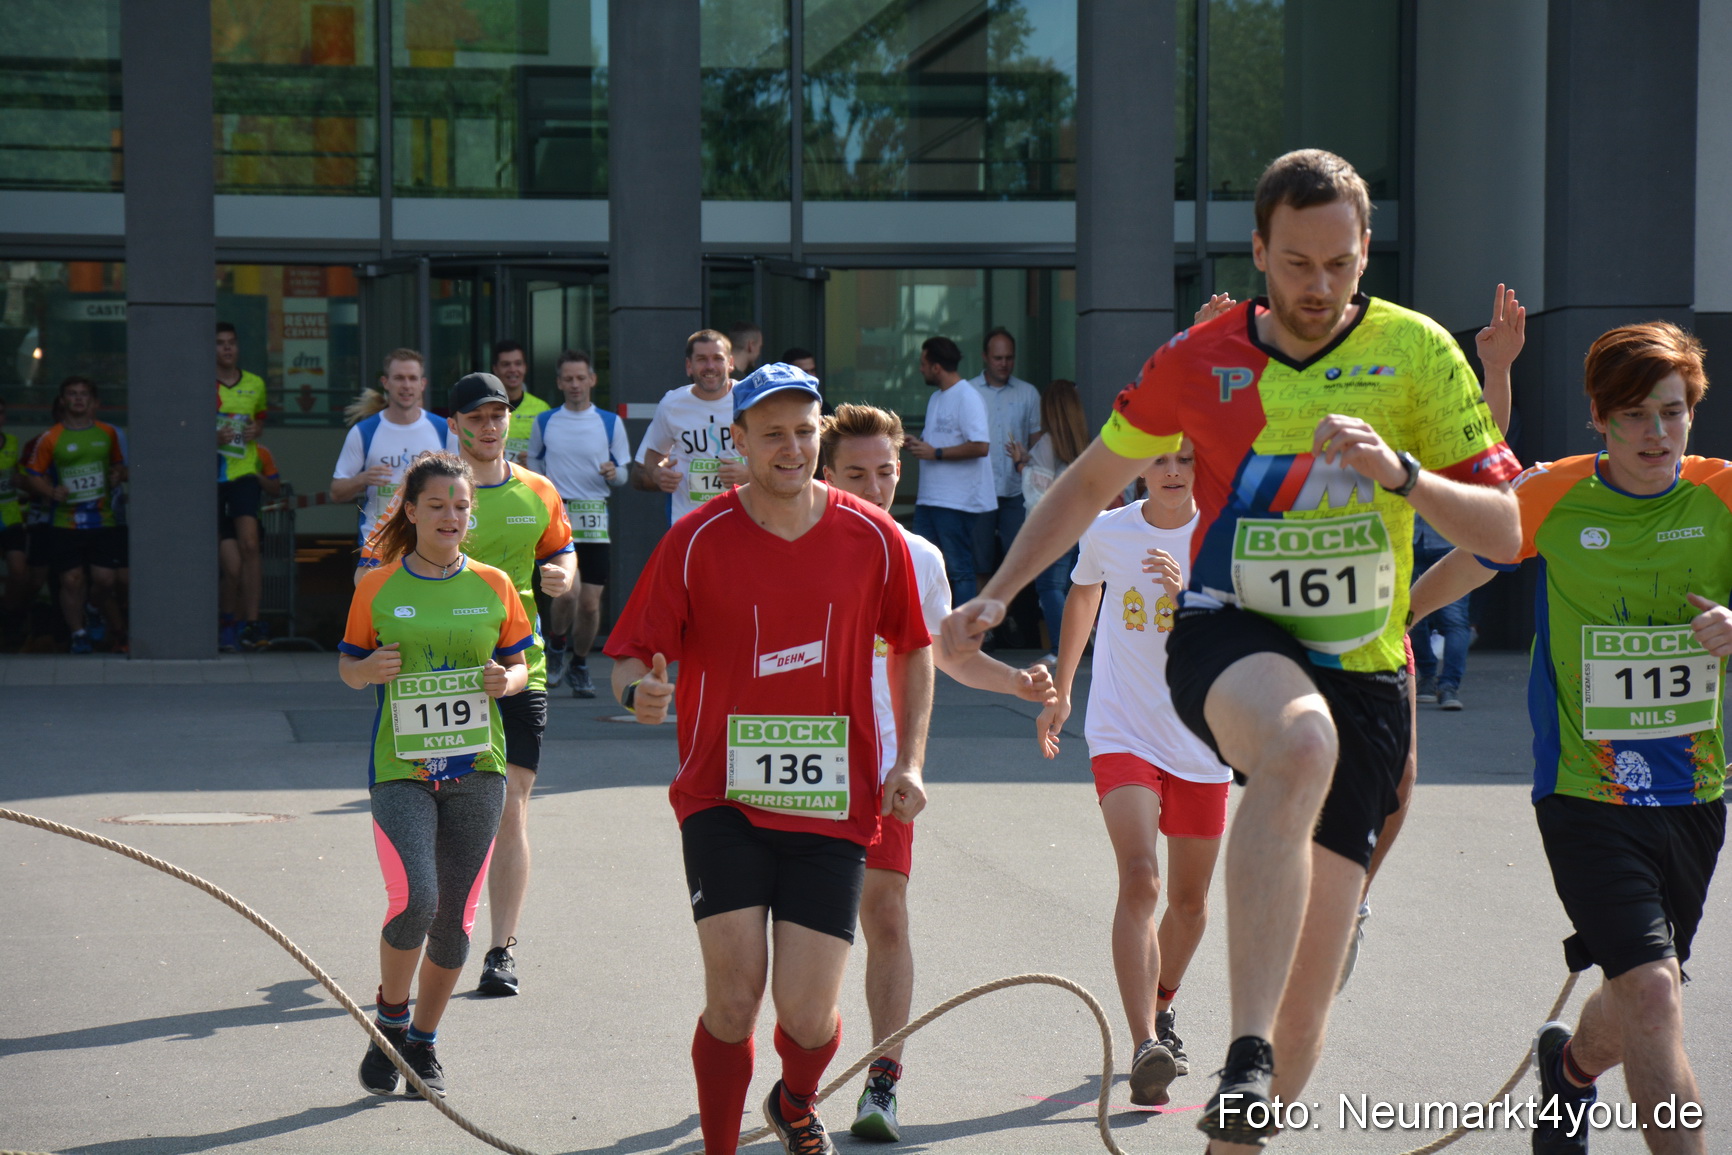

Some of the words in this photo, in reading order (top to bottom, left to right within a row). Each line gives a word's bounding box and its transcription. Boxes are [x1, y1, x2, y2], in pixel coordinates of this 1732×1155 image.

[284, 314, 327, 327] REWE
[284, 327, 327, 338] CENTER
[292, 351, 321, 367] dm
[681, 415, 735, 458] SUSP
[71, 476, 97, 490] 122
[701, 475, 722, 489] 14
[506, 516, 536, 524] BOCK
[1244, 519, 1379, 556] BOCK
[1657, 526, 1706, 542] BOCK
[1270, 566, 1357, 607] 161
[453, 607, 488, 616] BOCK
[1593, 629, 1707, 656] BOCK
[776, 651, 806, 667] DEHN
[397, 671, 481, 697] BOCK
[1614, 665, 1691, 700] 113
[414, 699, 471, 728] 119
[1630, 709, 1677, 726] NILS
[737, 720, 838, 744] BOCK
[423, 734, 465, 748] KYRA
[756, 754, 823, 785] 136
[738, 793, 837, 808] CHRISTIAN
